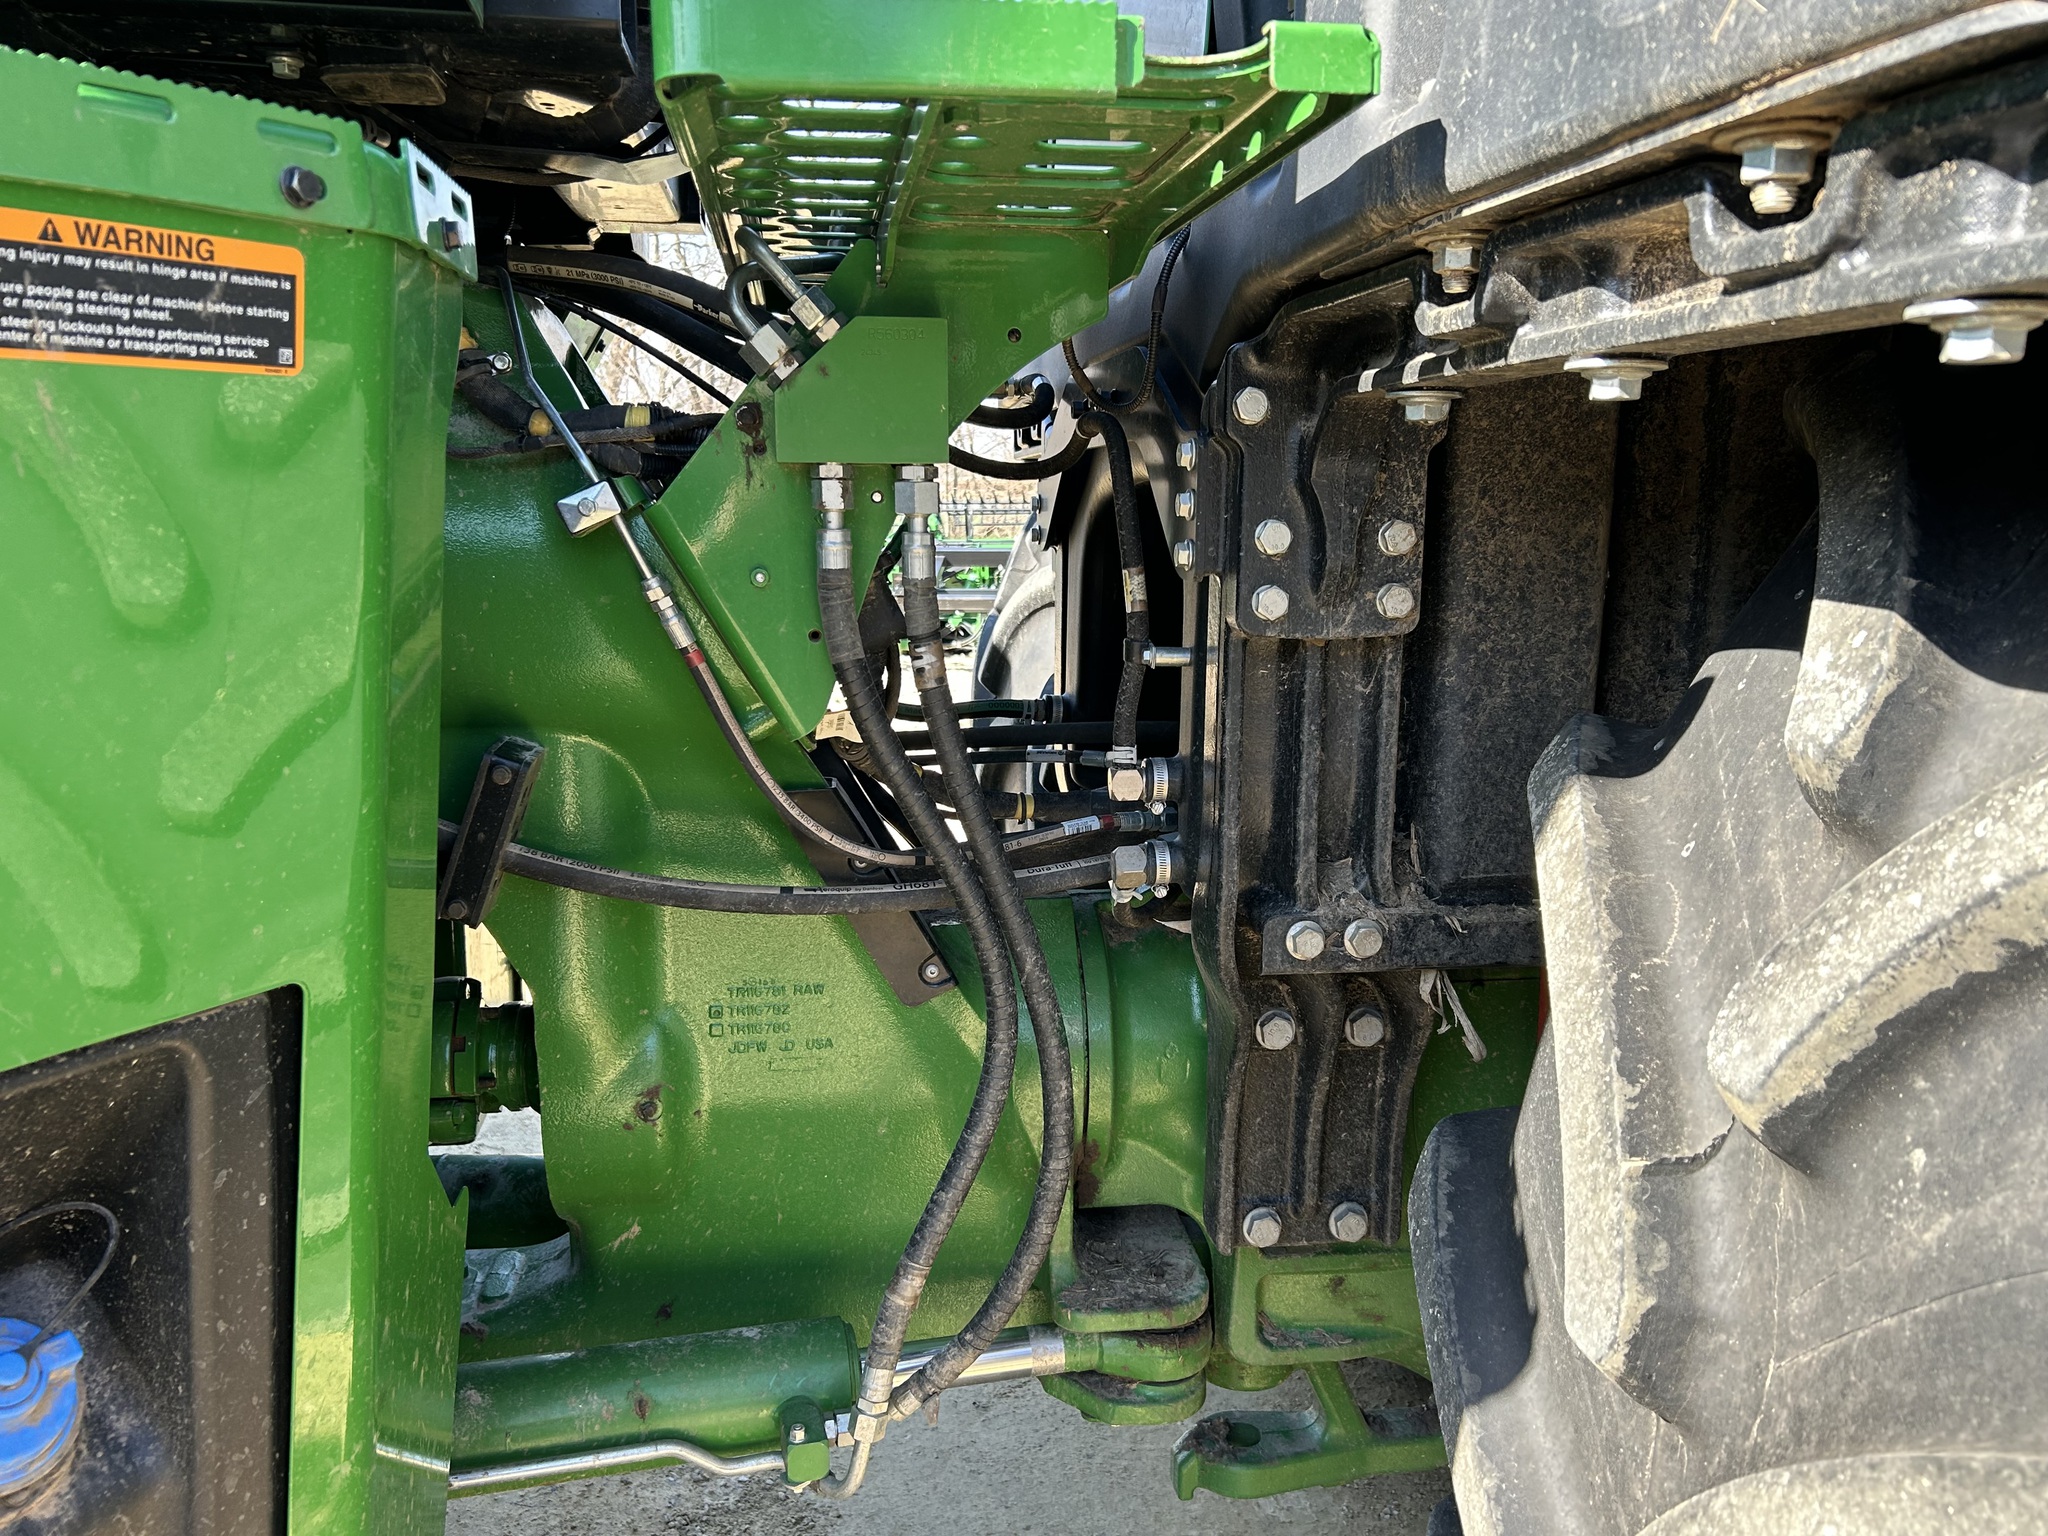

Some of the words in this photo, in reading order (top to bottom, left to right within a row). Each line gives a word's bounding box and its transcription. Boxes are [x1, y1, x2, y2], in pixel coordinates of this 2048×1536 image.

[73, 220, 214, 262] WARNING
[20, 247, 60, 267] injury
[63, 254, 91, 270] may
[95, 258, 133, 273] result
[136, 260, 149, 274] in
[152, 262, 187, 280] hinge
[190, 268, 216, 281] area
[219, 270, 228, 282] if
[230, 274, 278, 288] machine
[281, 277, 291, 290] is
[566, 269, 575, 277] 21
[575, 269, 591, 279] MPa
[2, 296, 19, 308] or
[22, 297, 74, 316] moving
[76, 301, 130, 320] steering
[132, 306, 173, 321] wheel.
[27, 284, 74, 299] people
[76, 289, 99, 301] are
[101, 290, 133, 304] clear
[136, 293, 150, 305] of
[152, 296, 204, 311] machine
[206, 301, 244, 315] before
[246, 305, 289, 322] starting
[696, 303, 720, 319] Parker
[0, 315, 56, 333] steerng
[58, 318, 114, 335] lockouts
[115, 323, 156, 338] before
[157, 328, 221, 346] performing
[223, 334, 269, 347] services
[868, 327, 926, 341] R560304
[32, 331, 48, 343] of
[50, 334, 105, 348] machine
[106, 337, 120, 349] or
[123, 338, 197, 357] transporting
[199, 345, 215, 356] on
[217, 346, 225, 356] a
[226, 346, 258, 359] truck.
[783, 797, 796, 811] BAR
[540, 852, 564, 863] BAR
[793, 983, 826, 996] RAW
[805, 1037, 834, 1051] USA
